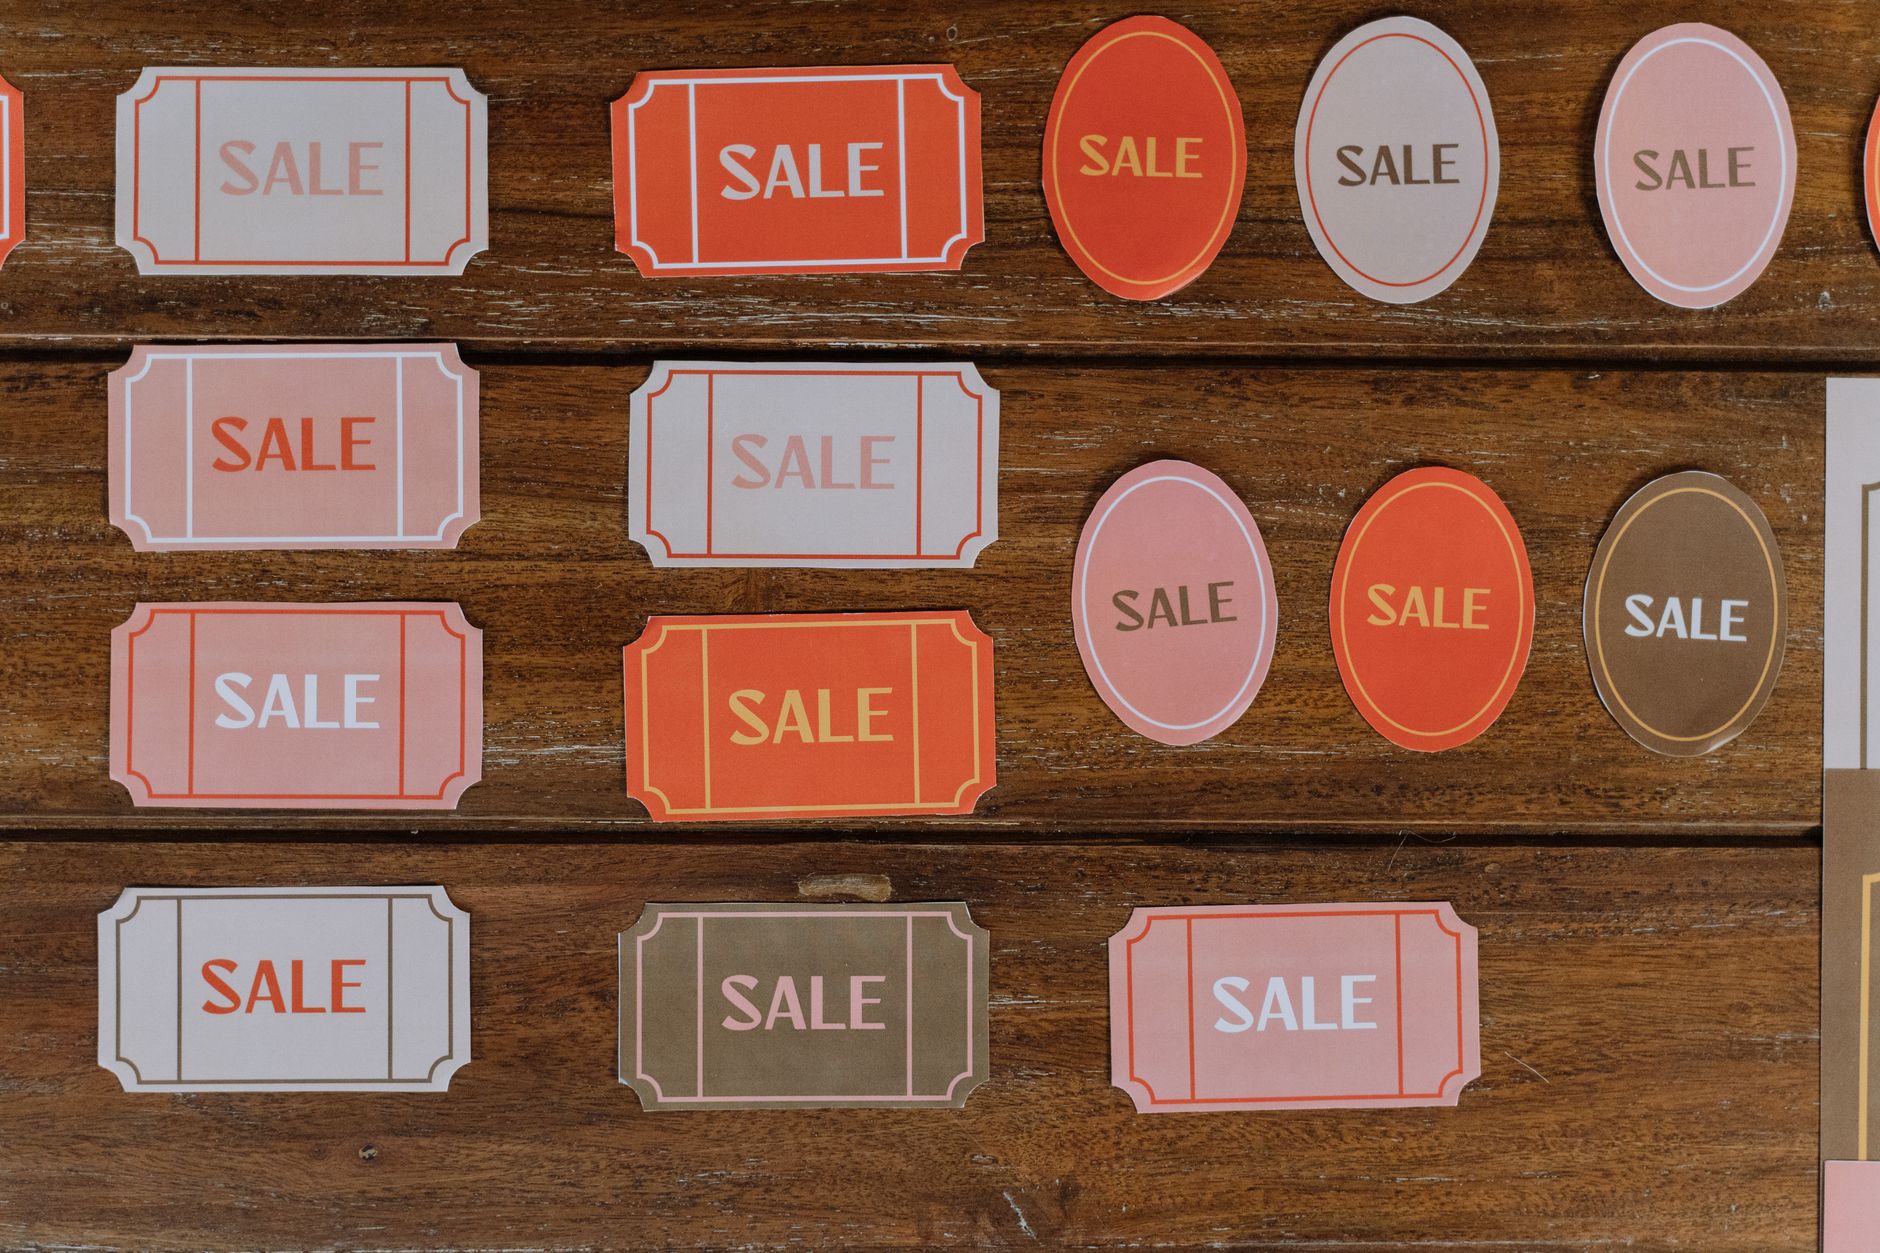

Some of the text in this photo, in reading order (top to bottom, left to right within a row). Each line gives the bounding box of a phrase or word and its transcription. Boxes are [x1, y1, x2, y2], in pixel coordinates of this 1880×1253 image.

[220, 140, 384, 195] SALE
[720, 143, 884, 200] SALE
[1080, 135, 1203, 178] SALE
[1337, 144, 1460, 186] SALE
[1633, 147, 1755, 191] SALE
[212, 417, 376, 472] SALE
[732, 434, 895, 489] SALE
[1113, 581, 1237, 631] SALE
[1368, 584, 1490, 629] SALE
[1625, 594, 1748, 641] SALE
[215, 673, 380, 728] SALE
[729, 688, 893, 745] SALE
[202, 959, 366, 1014] SALE
[722, 975, 886, 1030] SALE
[1213, 975, 1377, 1032] SALE
